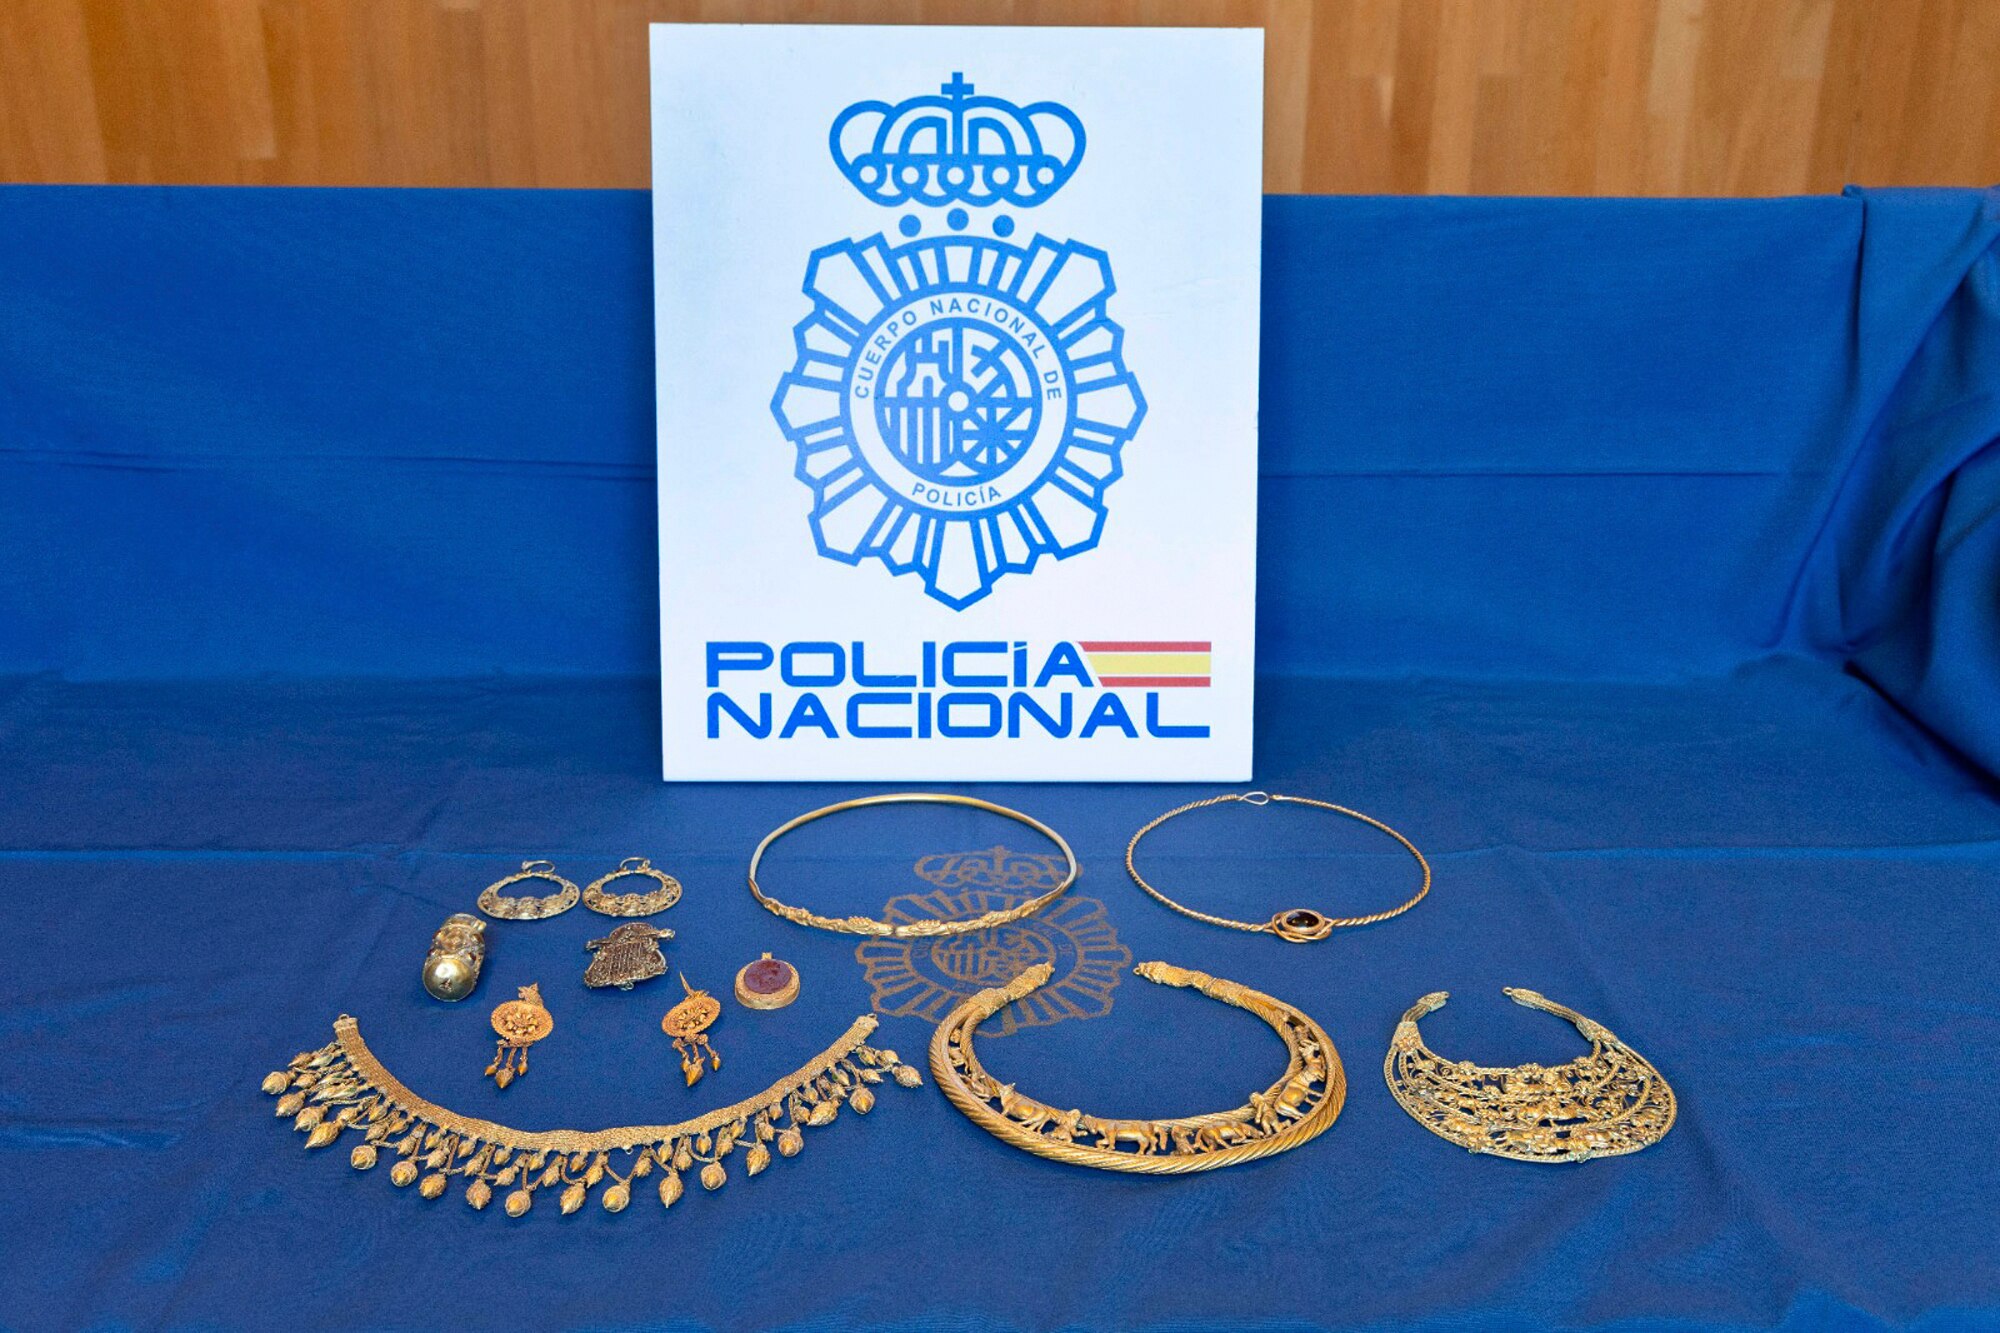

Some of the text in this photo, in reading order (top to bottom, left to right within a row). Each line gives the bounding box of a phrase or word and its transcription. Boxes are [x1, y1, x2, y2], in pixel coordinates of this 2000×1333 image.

[854, 297, 1062, 401] CUERPO NACIONAL DE
[911, 482, 1002, 507] POLICÍA
[706, 692, 1210, 739] NACIONAL
